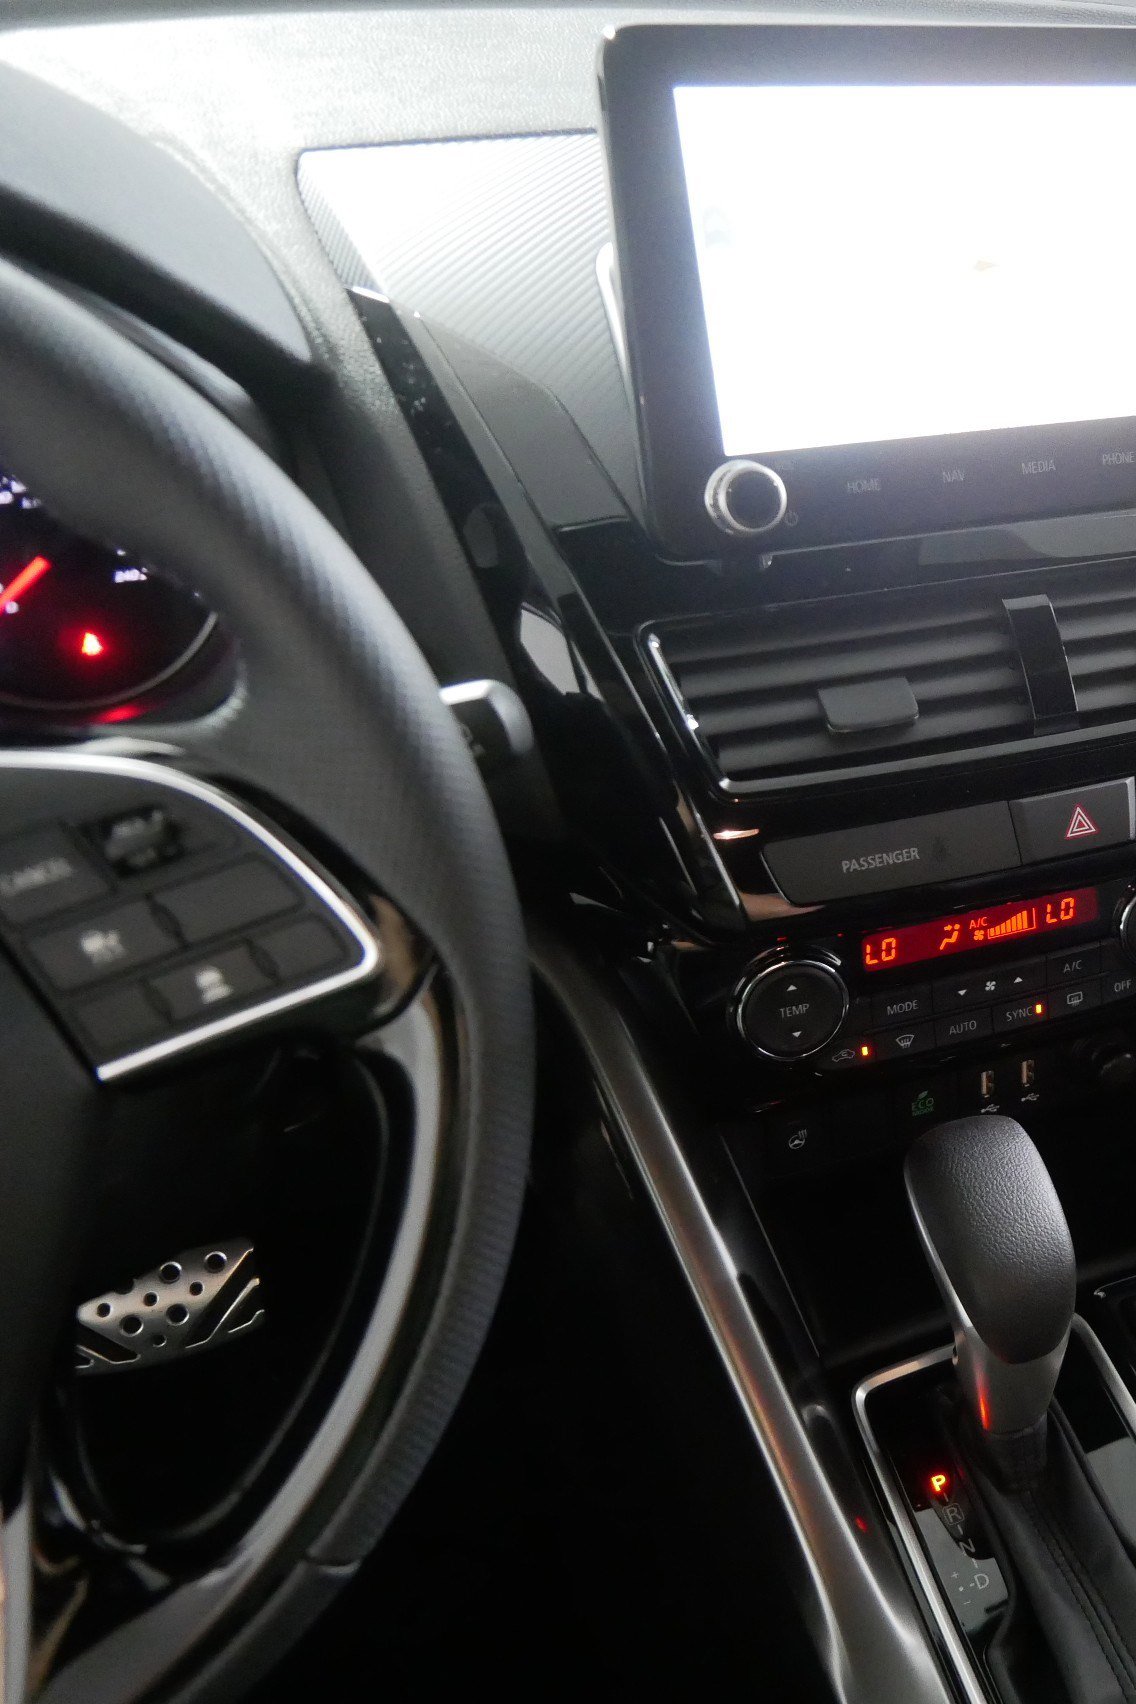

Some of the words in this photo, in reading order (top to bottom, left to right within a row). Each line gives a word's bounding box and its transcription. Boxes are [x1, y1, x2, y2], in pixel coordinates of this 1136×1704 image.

[1102, 451, 1136, 466] PHONE
[1021, 459, 1056, 475] MEDIA
[942, 469, 965, 483] NAV
[847, 478, 881, 494] HOME
[841, 847, 921, 874] PASSENGER
[969, 916, 988, 930] A/C
[1063, 959, 1083, 974] A/C
[1114, 979, 1132, 993] OFF
[778, 1002, 810, 1019] TEMP
[886, 1000, 919, 1016] MODE
[1005, 1006, 1033, 1022] SYNC
[949, 1020, 977, 1036] AUTO
[931, 1474, 946, 1492] P
[947, 1506, 963, 1523] R
[958, 1537, 976, 1553] N
[973, 1573, 990, 1590] D
